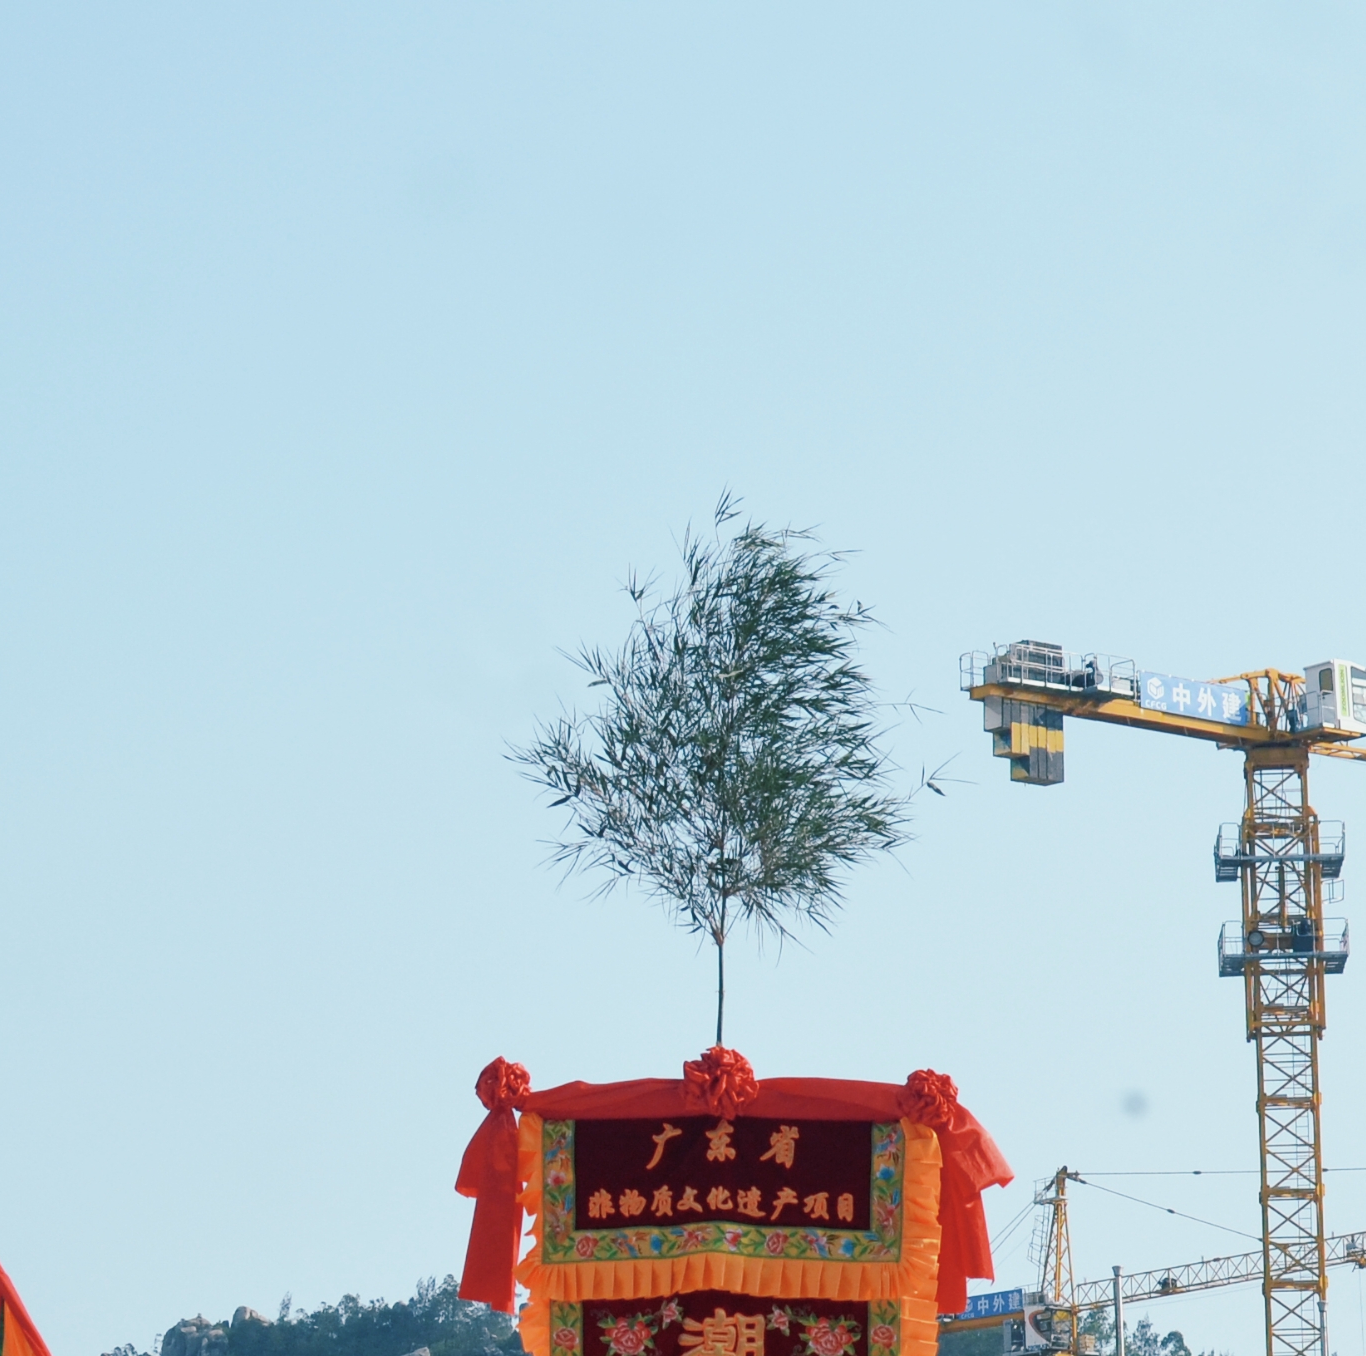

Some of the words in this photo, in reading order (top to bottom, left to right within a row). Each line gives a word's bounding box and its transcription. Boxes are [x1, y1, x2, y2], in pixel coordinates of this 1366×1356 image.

[1144, 699, 1167, 711] CFCG
[1172, 682, 1242, 722] 中外建
[645, 1119, 800, 1171] 广东省
[977, 1291, 1021, 1316] 中外建
